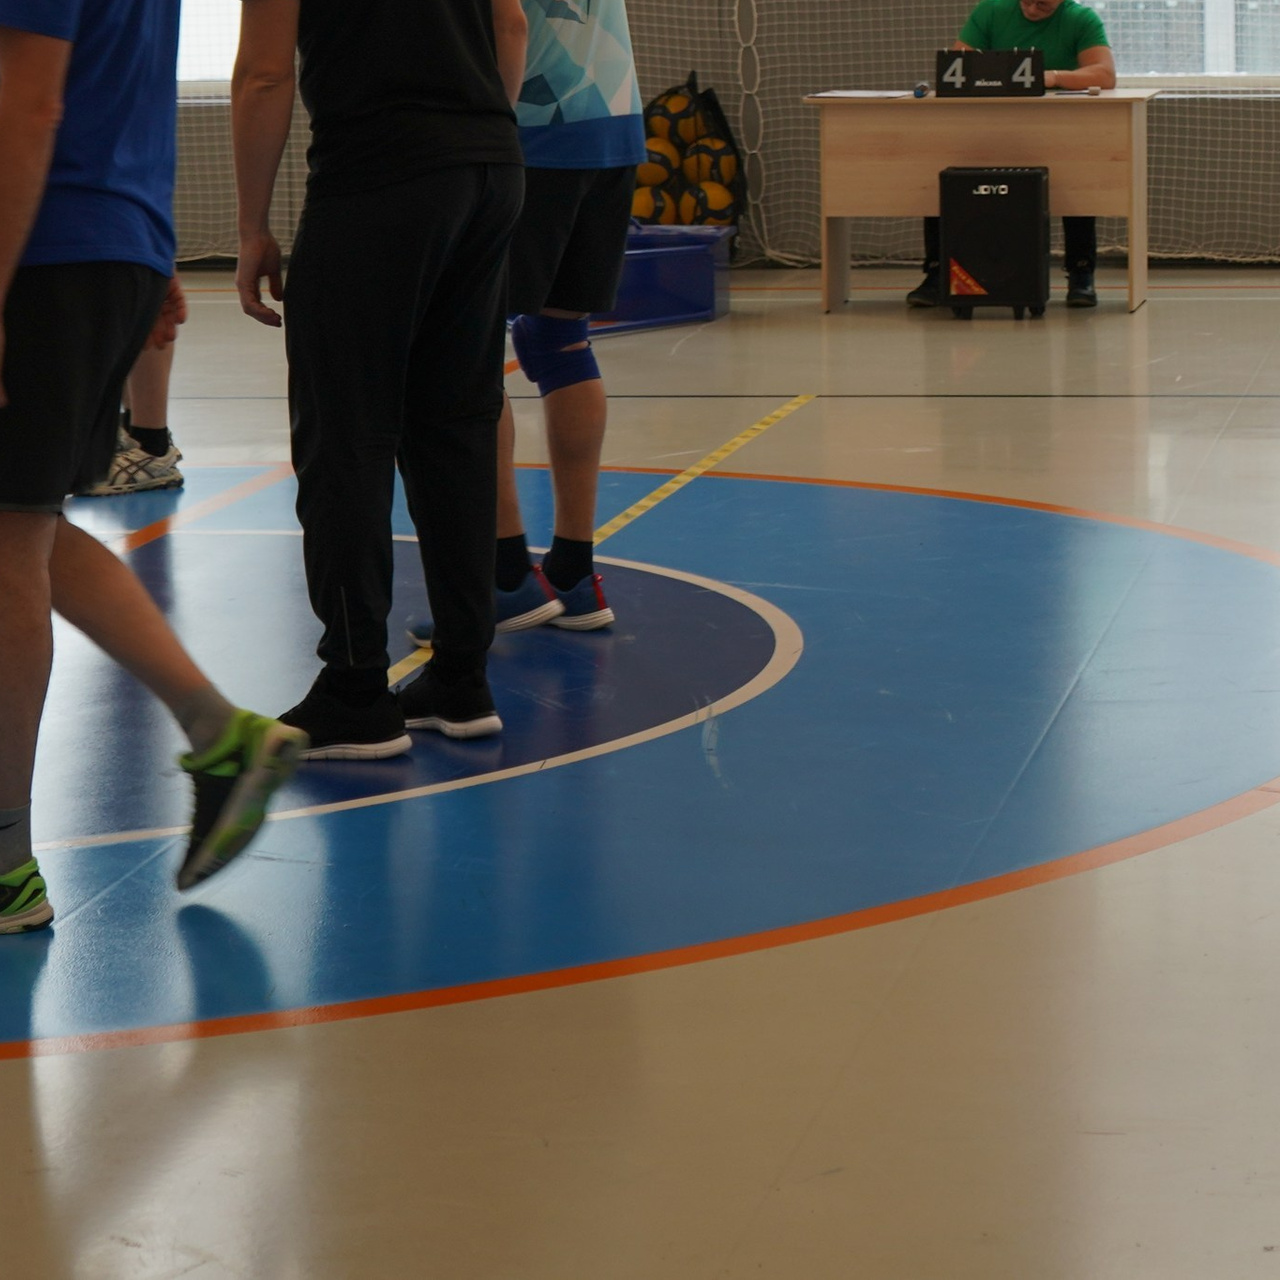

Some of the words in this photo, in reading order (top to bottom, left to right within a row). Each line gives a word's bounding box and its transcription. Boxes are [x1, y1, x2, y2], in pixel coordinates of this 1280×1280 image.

[942, 57, 966, 88] 4
[1011, 57, 1036, 89] 4
[972, 184, 1009, 195] JOYO
